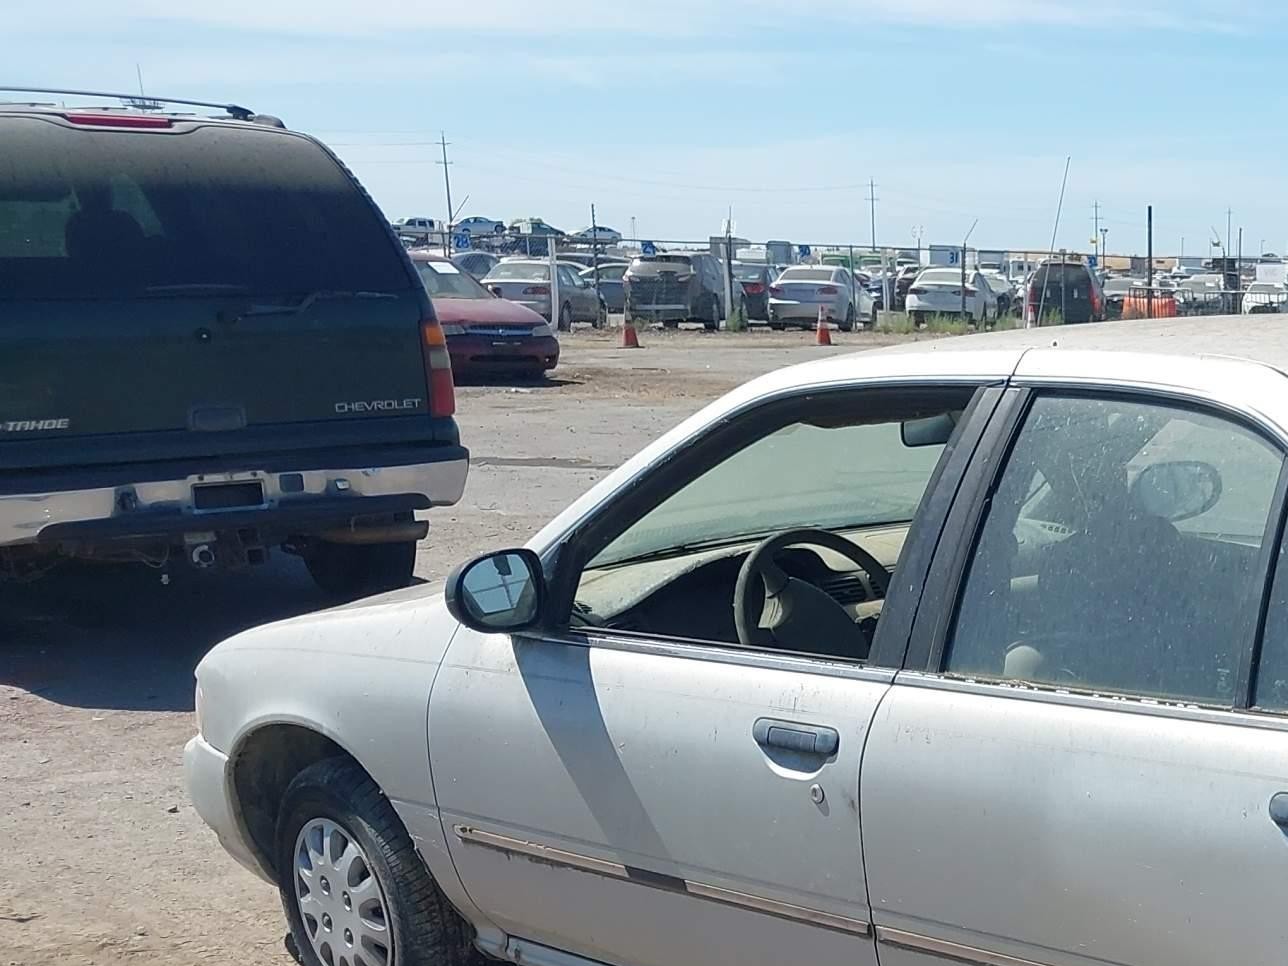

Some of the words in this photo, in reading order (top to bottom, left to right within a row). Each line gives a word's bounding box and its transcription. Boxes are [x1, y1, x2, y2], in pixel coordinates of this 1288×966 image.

[949, 251, 959, 264] 31
[335, 398, 421, 413] CHEVROLET
[6, 418, 70, 431] TAHOE
